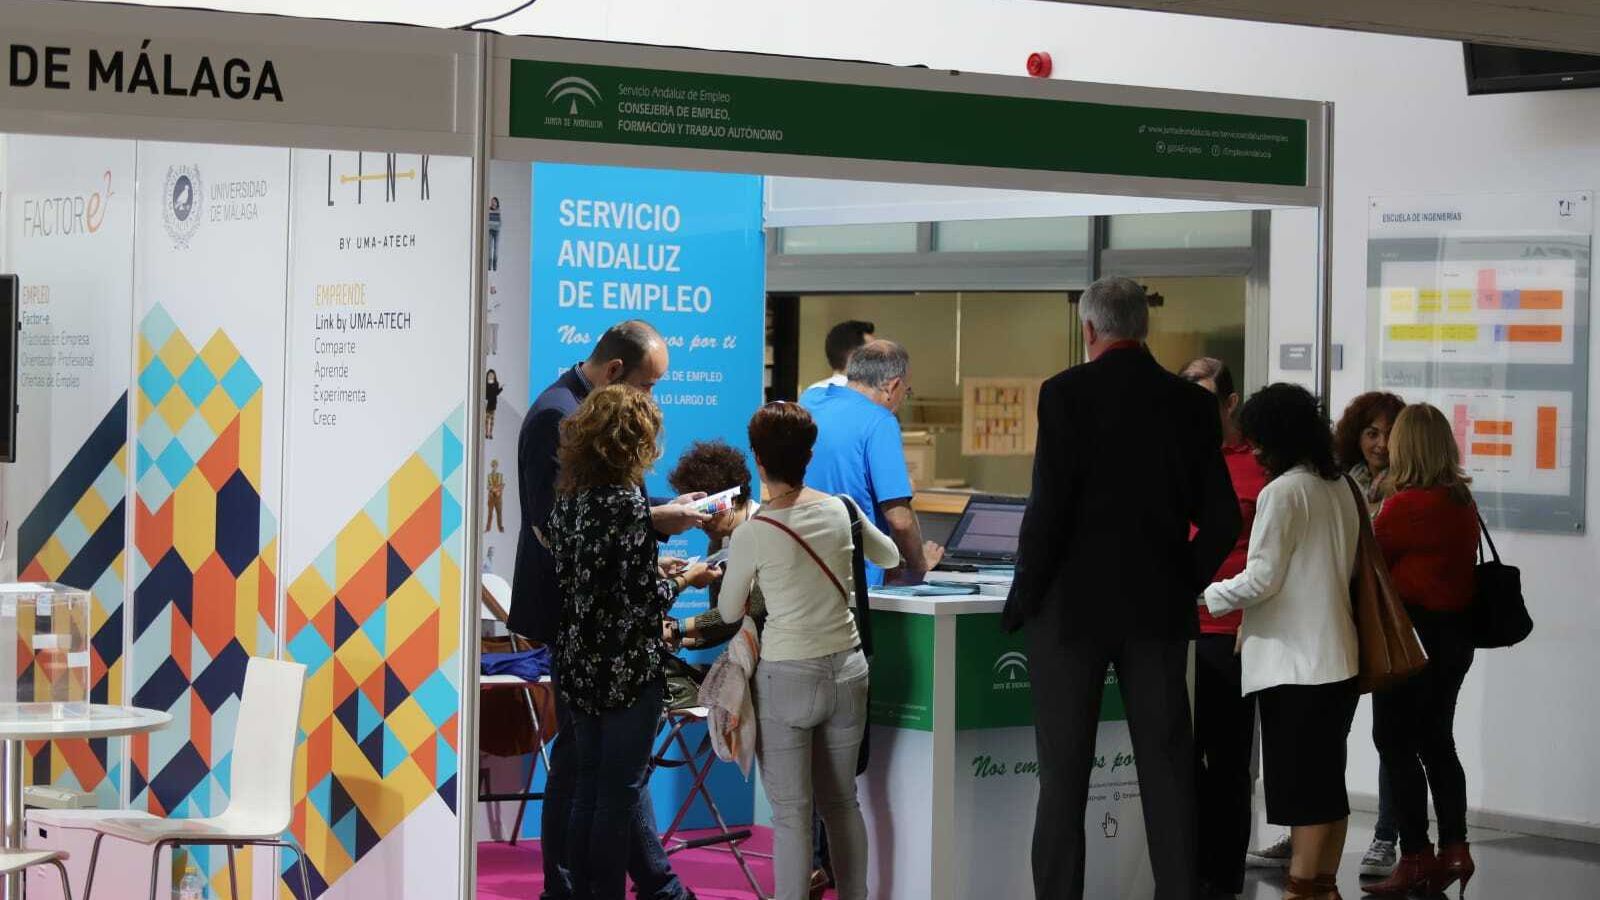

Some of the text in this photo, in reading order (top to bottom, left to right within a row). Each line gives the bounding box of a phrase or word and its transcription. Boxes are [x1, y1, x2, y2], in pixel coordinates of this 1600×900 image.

[10, 39, 284, 102] DE MÁLAGA
[618, 83, 730, 105] Servicio Andaluz de Empleo
[617, 101, 675, 117] CONSEJERÍA
[676, 106, 690, 117] DE
[617, 118, 783, 142] FORMACIÓN Y TRABAJO AUTÓNOMO
[327, 152, 430, 206] LINK
[210, 180, 268, 201] UNIVERSIDAD
[210, 205, 222, 222] DE
[559, 199, 681, 233] SERVICIO
[1382, 213, 1411, 223] ESCUELA
[1412, 212, 1421, 222] DE
[339, 234, 416, 250] BY UMA-ATECH
[557, 240, 681, 272] ANDALUZ
[23, 285, 50, 305] EMPLEO
[316, 283, 367, 306] EMPRENDE
[559, 280, 712, 313] DE EMPLEO
[315, 312, 411, 333] Link by UMA-ATECH
[314, 337, 356, 357] Comparte
[557, 325, 591, 345] Nos
[689, 334, 717, 353] por
[314, 360, 349, 381] Aprende
[672, 371, 685, 381] DE
[686, 371, 723, 382] EMPLEO
[313, 384, 367, 405] Experimenta
[660, 394, 672, 404] LO
[674, 394, 704, 406] LARGO
[705, 395, 718, 406] DE
[313, 408, 337, 426] Crece
[972, 755, 1008, 778] Nos
